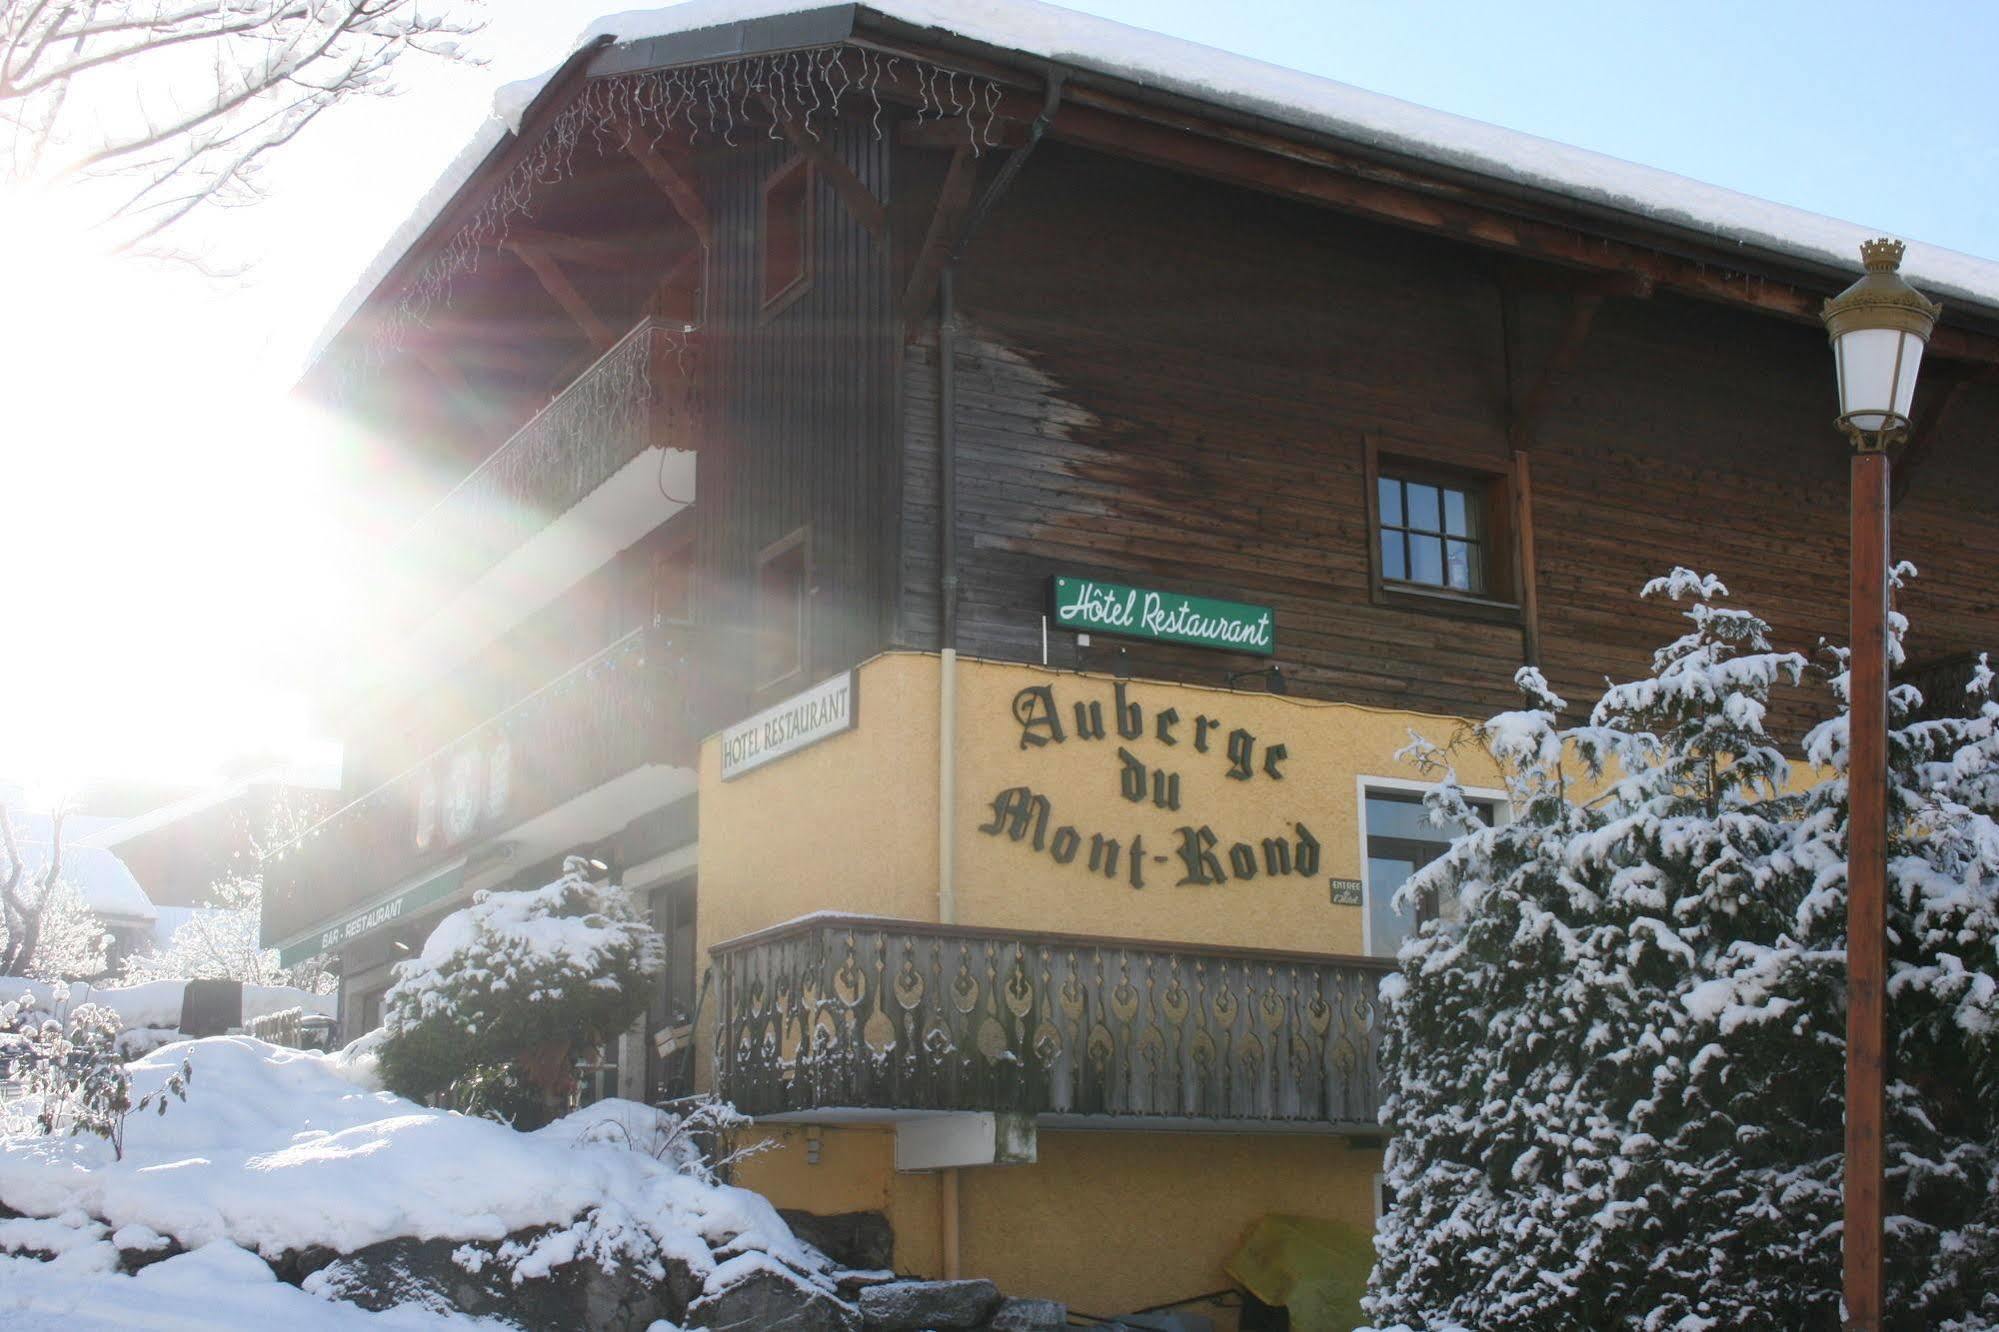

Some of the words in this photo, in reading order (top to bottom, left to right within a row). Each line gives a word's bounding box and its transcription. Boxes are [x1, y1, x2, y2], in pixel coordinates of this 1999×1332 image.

[1059, 582, 1137, 627] Hôtel
[1141, 591, 1270, 646] Restaurant
[723, 727, 762, 769] HOTEL
[764, 688, 848, 750] RESTAURANT
[1012, 681, 1289, 781] Auberge
[1118, 746, 1181, 812] du
[978, 785, 1321, 890] Mont-Rond
[322, 927, 339, 949] BAR
[345, 898, 404, 939] RESTAURANT
